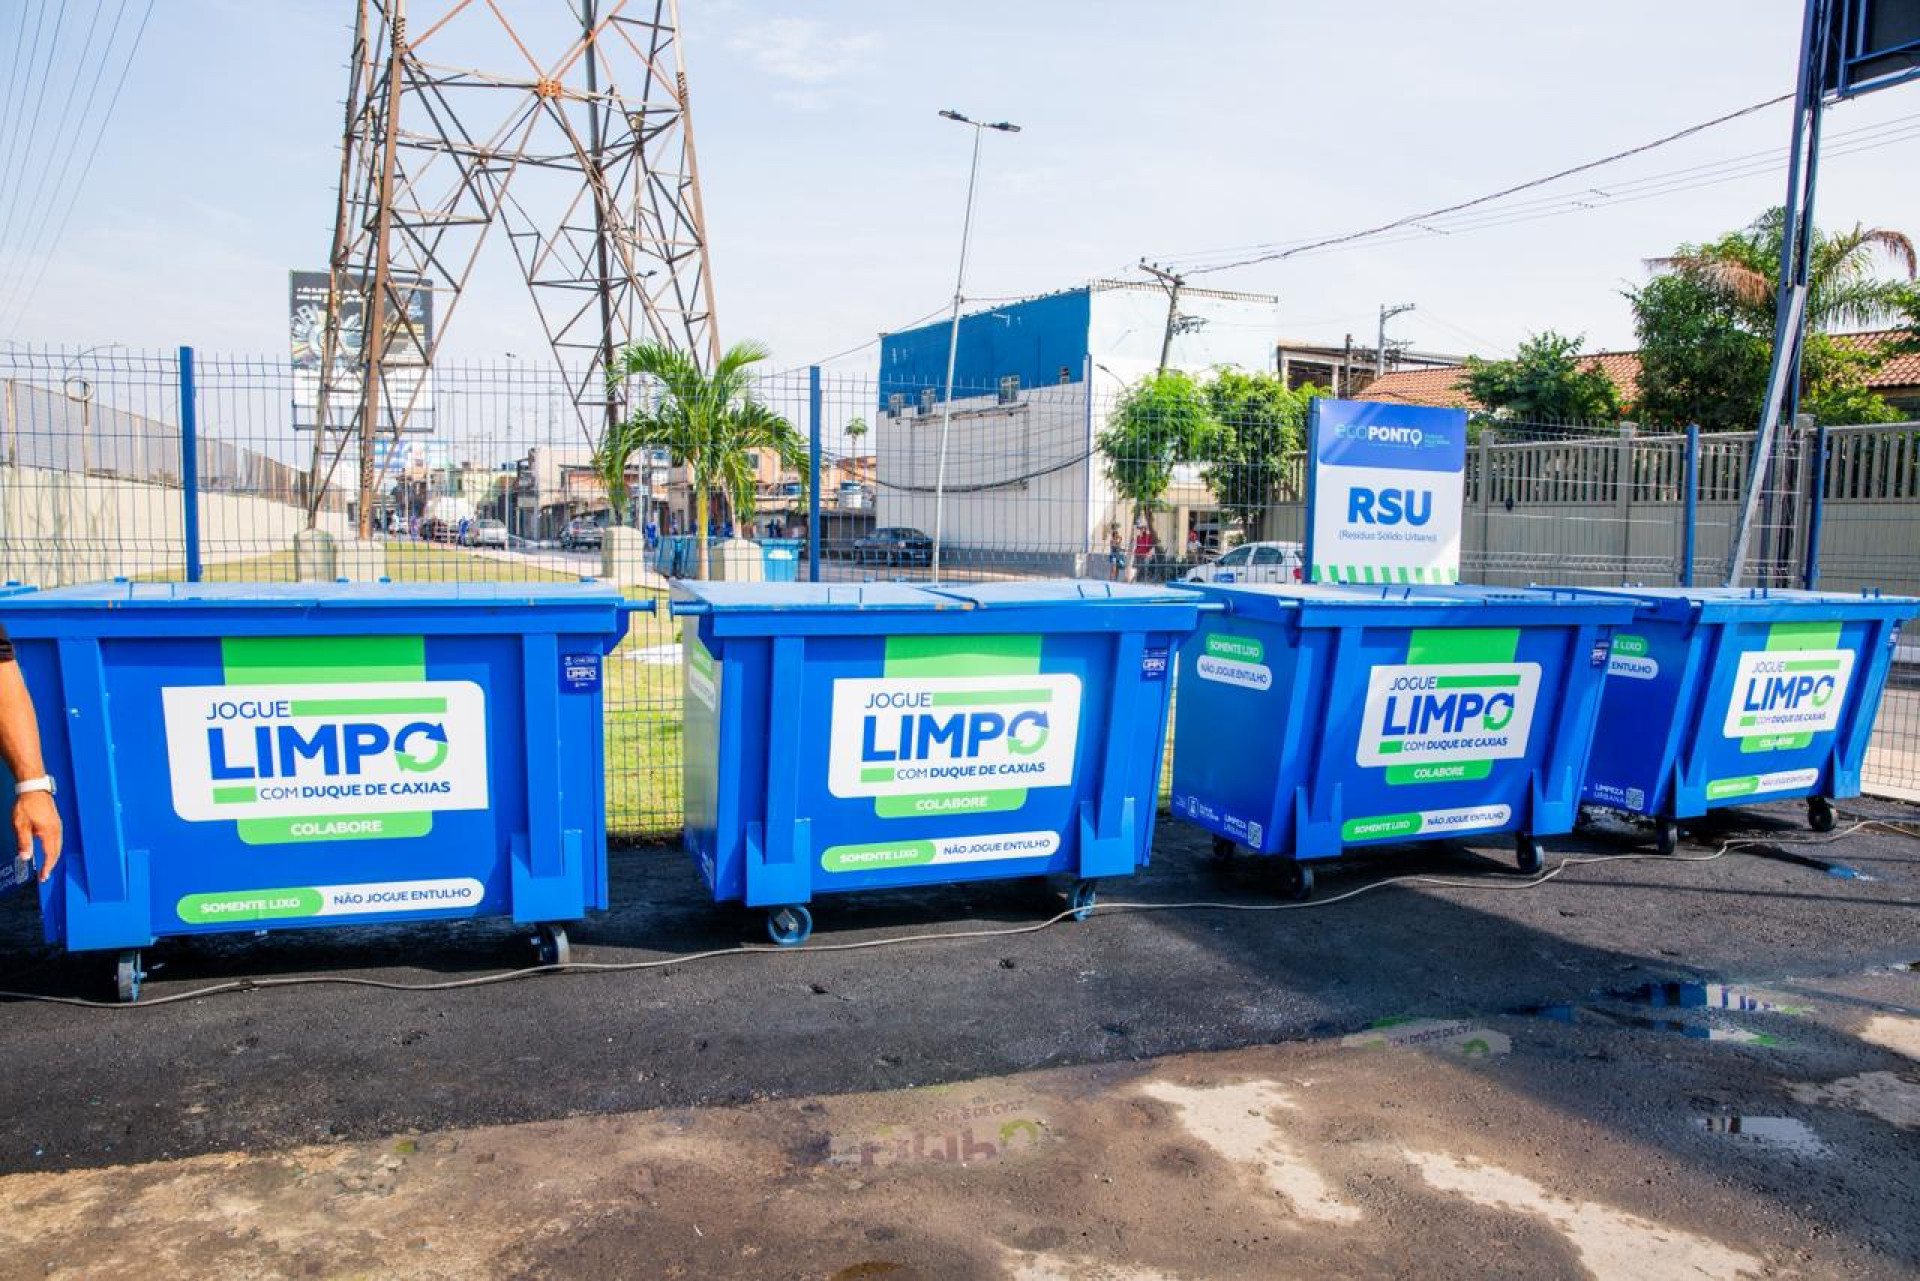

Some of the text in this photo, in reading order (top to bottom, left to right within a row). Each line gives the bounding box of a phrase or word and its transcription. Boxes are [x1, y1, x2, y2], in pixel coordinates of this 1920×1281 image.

[1347, 487, 1432, 526] RSU
[1751, 661, 1785, 673] JOGUE
[1389, 676, 1437, 691] JOGUE
[864, 692, 932, 708] JOGUE
[1743, 674, 1836, 712] LIMPO
[206, 701, 290, 720] JOGUE
[1381, 692, 1515, 736] LIMPO
[861, 710, 1050, 762] LIMPO
[1404, 737, 1508, 751] COM DUQUE DE CAXIAS
[207, 721, 448, 780] LIMPO
[897, 762, 1045, 780] COM DUQUE DE CAXIAS
[1413, 766, 1465, 779] COLABORE
[260, 781, 450, 800] COM DUQUE DE CAXIAS
[915, 796, 988, 811] COLABORE
[290, 820, 383, 836] COLABORE
[943, 838, 1051, 855] NÃO JOGUE ENTULHO
[839, 848, 919, 864] SOMENTE LIXO
[333, 887, 472, 905] NÃO JOGUE ENTULHO
[200, 897, 301, 914] SOMENTE LIXO
